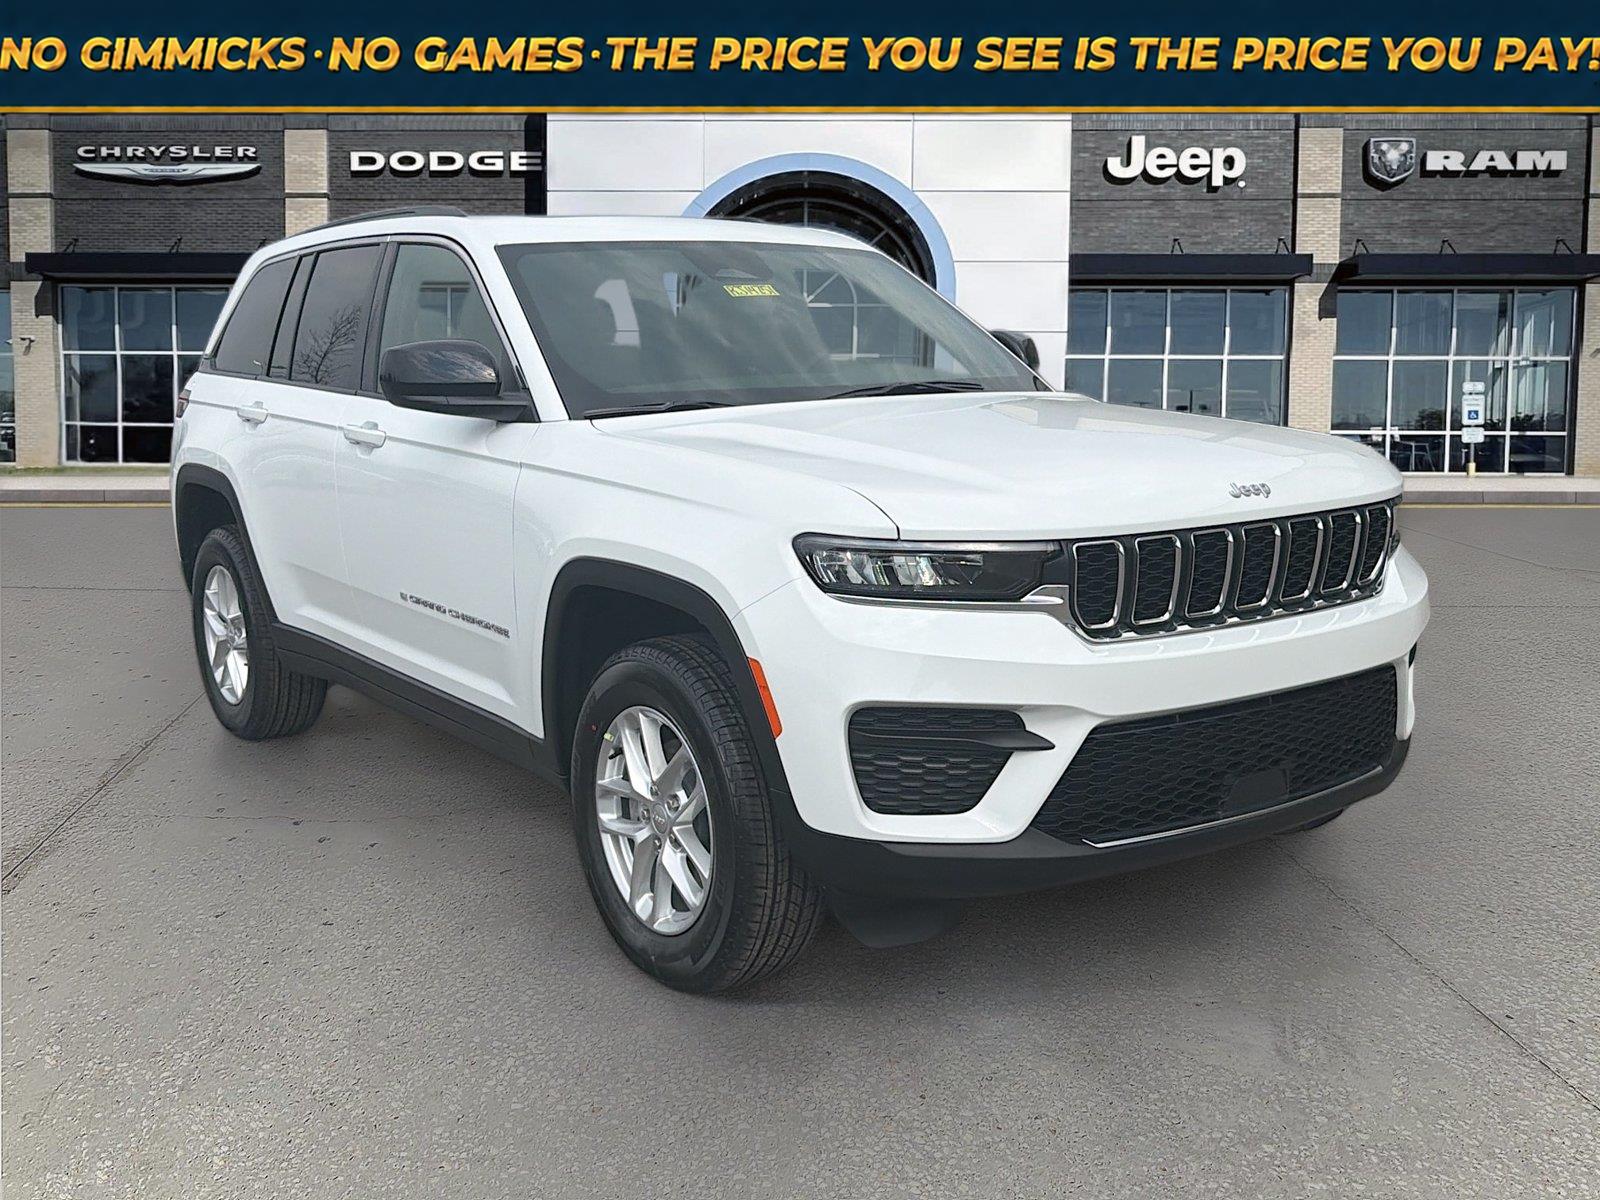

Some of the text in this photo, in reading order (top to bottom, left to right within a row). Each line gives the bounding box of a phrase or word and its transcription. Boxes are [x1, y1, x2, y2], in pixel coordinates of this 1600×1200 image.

[76, 145, 257, 158] CHRYSLER
[349, 150, 543, 172] DODGE
[1106, 134, 1247, 187] Jeep
[1425, 149, 1568, 171] RAM
[1228, 482, 1272, 499] Jeep
